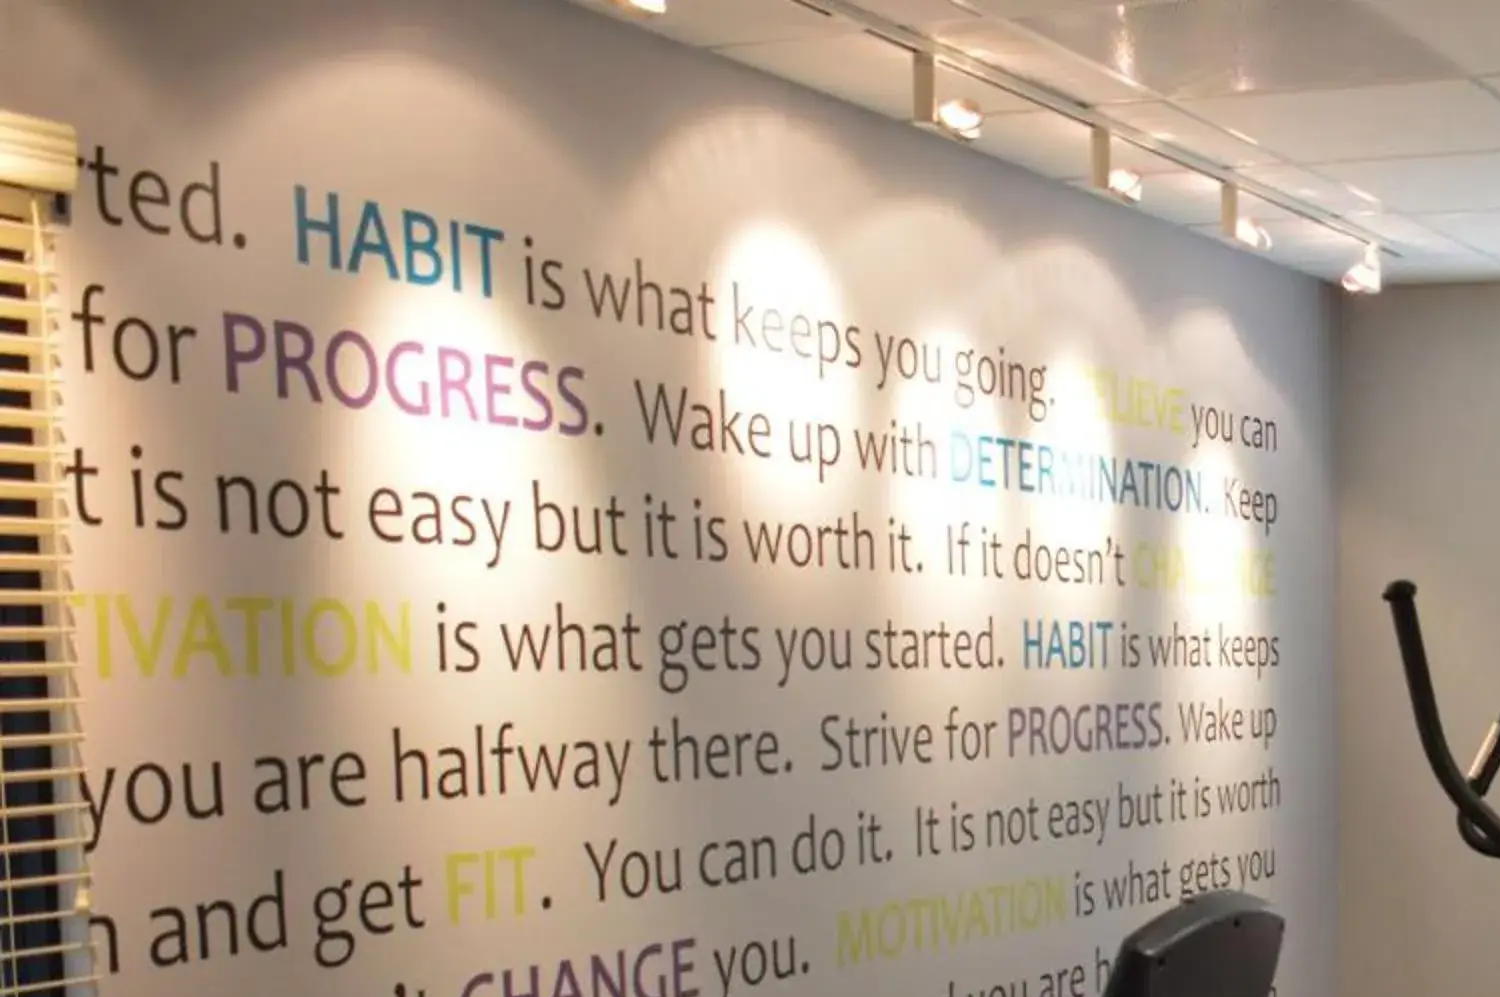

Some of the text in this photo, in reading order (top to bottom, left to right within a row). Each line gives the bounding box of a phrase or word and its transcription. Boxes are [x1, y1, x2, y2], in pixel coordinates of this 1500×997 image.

[79, 146, 247, 249] ted.
[295, 185, 504, 297] HABIT
[524, 236, 565, 310] is
[582, 258, 716, 341] what
[732, 281, 864, 380] keeps
[875, 331, 940, 390] you
[955, 346, 1054, 421] going.
[1191, 404, 1233, 448] you
[1240, 416, 1277, 451] can
[71, 284, 197, 384] for
[223, 312, 604, 437] PROGRESS.
[634, 379, 771, 458] Wake
[790, 421, 841, 483] up
[854, 418, 937, 477] with
[1225, 479, 1277, 536] Keep
[131, 445, 187, 530] is
[216, 469, 344, 540] not
[368, 487, 511, 569] easy
[532, 480, 628, 556] but
[644, 493, 678, 559] it
[694, 498, 728, 562] is
[743, 511, 874, 570] worth
[888, 517, 923, 574] it.
[947, 521, 970, 576] If
[982, 527, 1004, 579] it
[1013, 527, 1126, 587] doesn't
[437, 602, 480, 672] is
[500, 602, 642, 672] what
[658, 616, 761, 694] gets
[775, 627, 852, 688] you
[865, 616, 1004, 670] started.
[1024, 619, 1113, 670] HABIT
[1120, 621, 1141, 669] is
[1147, 621, 1212, 668] what
[1219, 623, 1279, 680] keeps
[79, 698, 1277, 851] you are halfway there. Strive for PROGRESS. Wake up
[149, 869, 287, 967] and
[313, 865, 425, 968] get
[444, 844, 553, 926] FIT.
[584, 838, 682, 902] You
[699, 836, 777, 887] can
[792, 813, 845, 875] do
[858, 810, 893, 865] it.
[916, 806, 941, 857] It
[951, 801, 975, 852] is
[986, 802, 1040, 848] not
[1048, 797, 1110, 846] easy
[1118, 782, 1164, 829] but
[1171, 778, 1187, 822] it
[1194, 776, 1211, 818] is
[1217, 767, 1280, 814] worth
[836, 879, 1067, 968] MOTIVATION
[1074, 870, 1095, 916] is
[1103, 859, 1171, 910] what
[1180, 855, 1231, 897] gets
[1237, 848, 1275, 887] you
